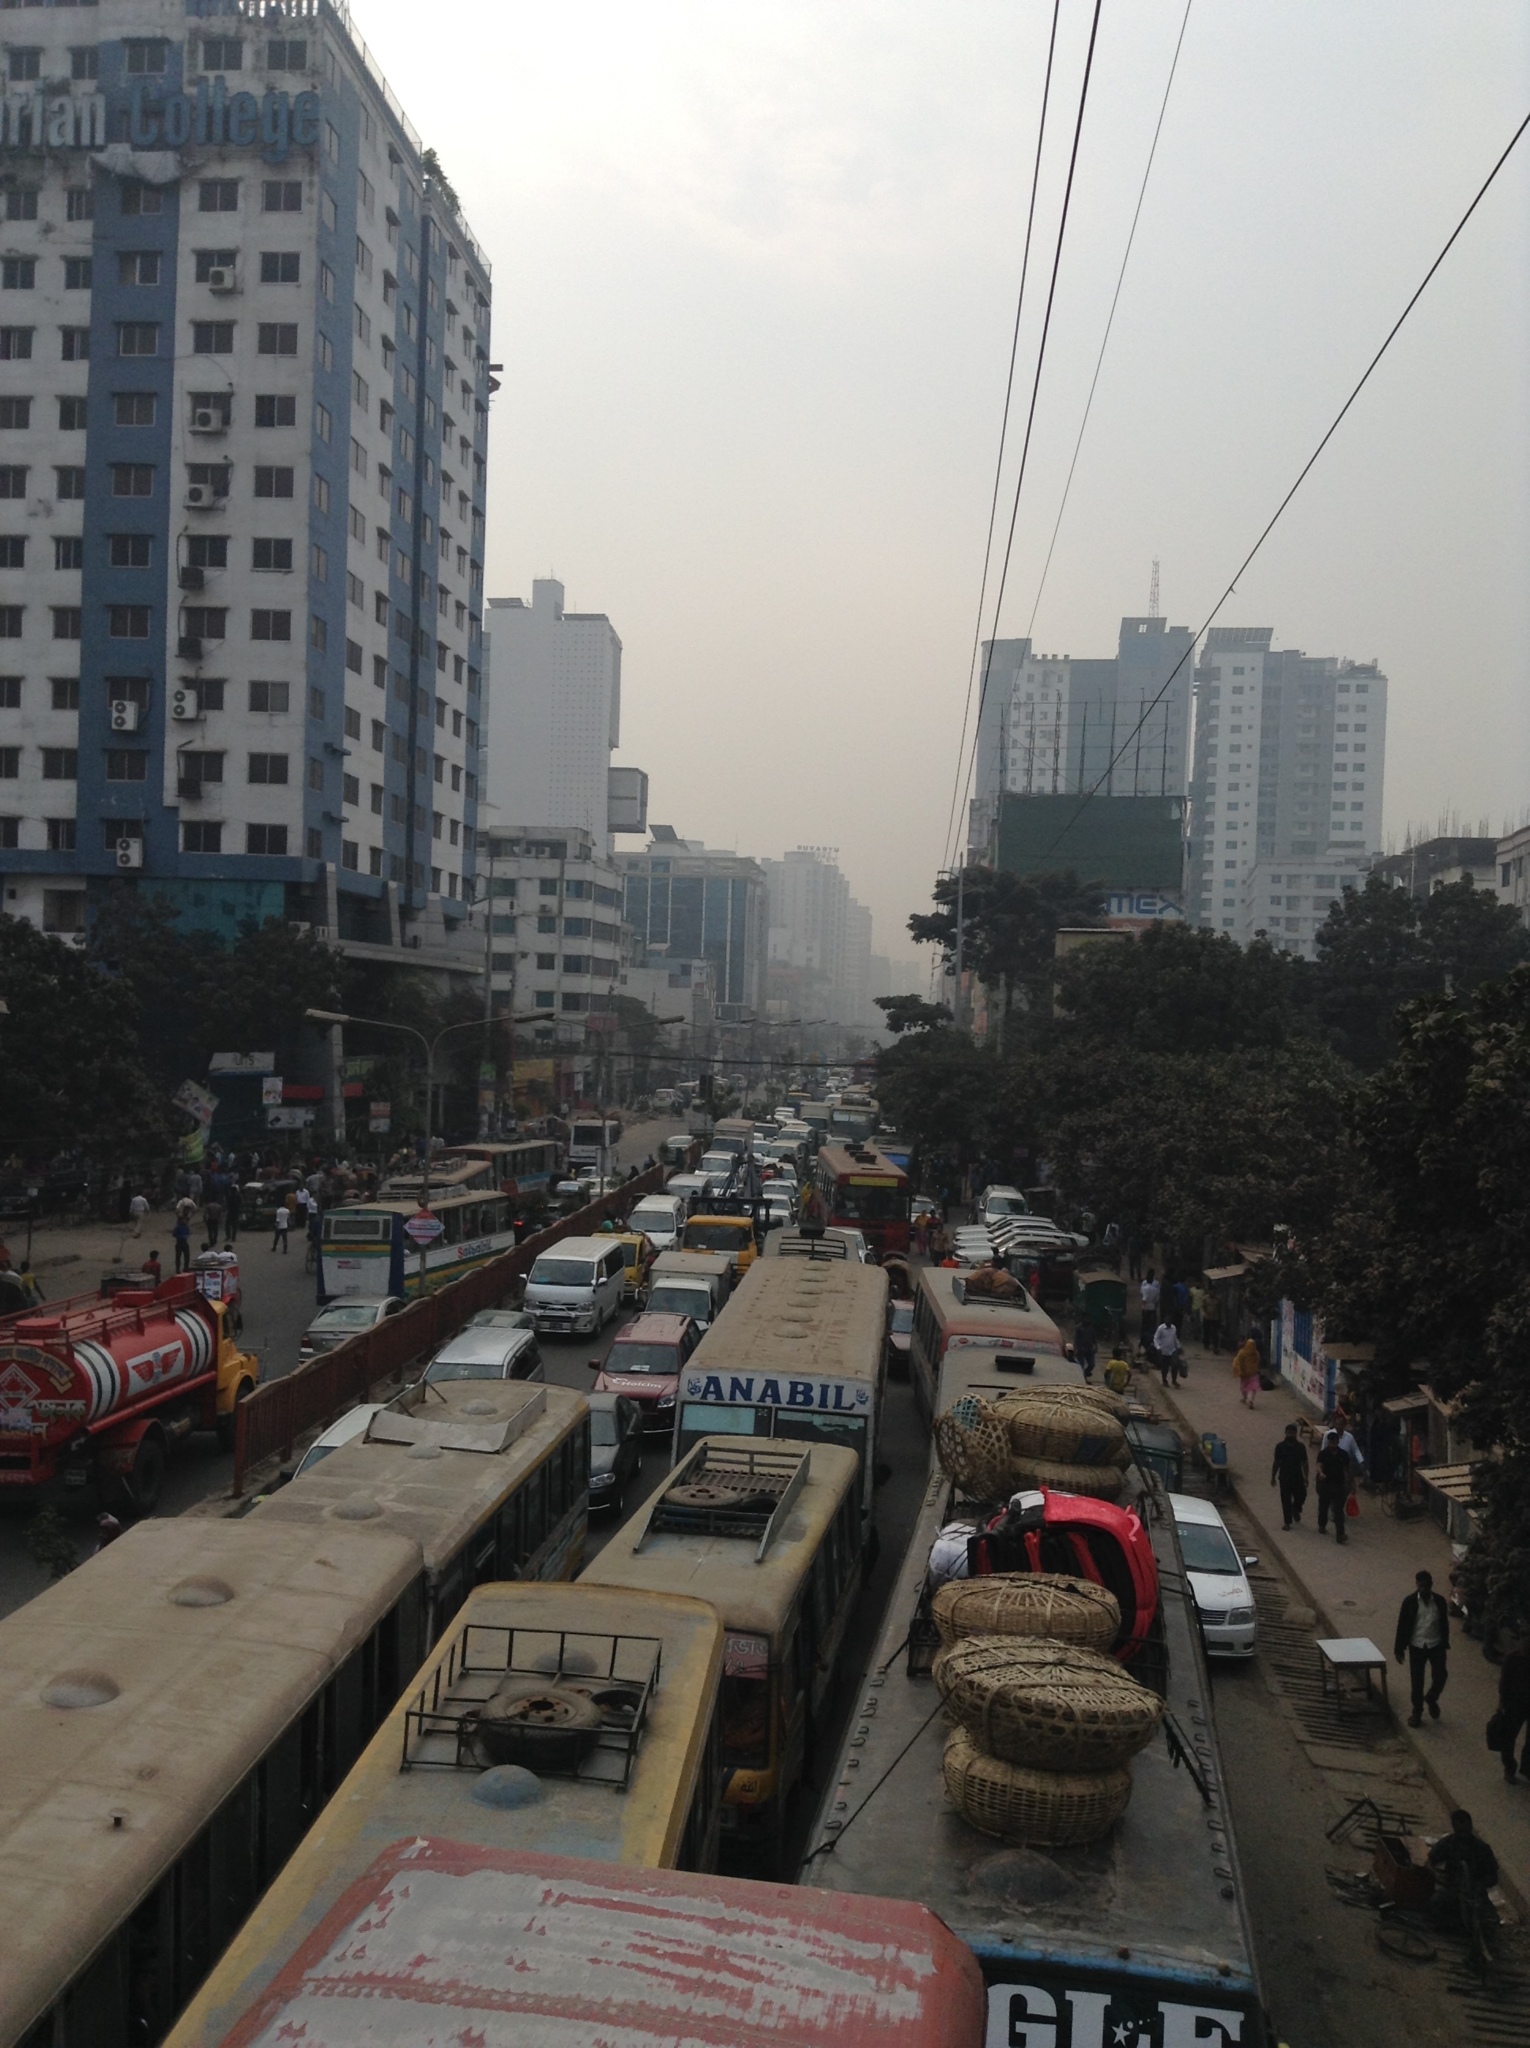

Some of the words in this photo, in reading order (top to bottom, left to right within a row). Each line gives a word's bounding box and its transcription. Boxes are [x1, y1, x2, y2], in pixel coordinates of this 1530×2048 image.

[0, 77, 106, 147] rian
[129, 75, 321, 163] College
[797, 845, 840, 853] SUVASTU
[621, 1380, 663, 1389] Holcim
[699, 1374, 857, 1411] ANABIL
